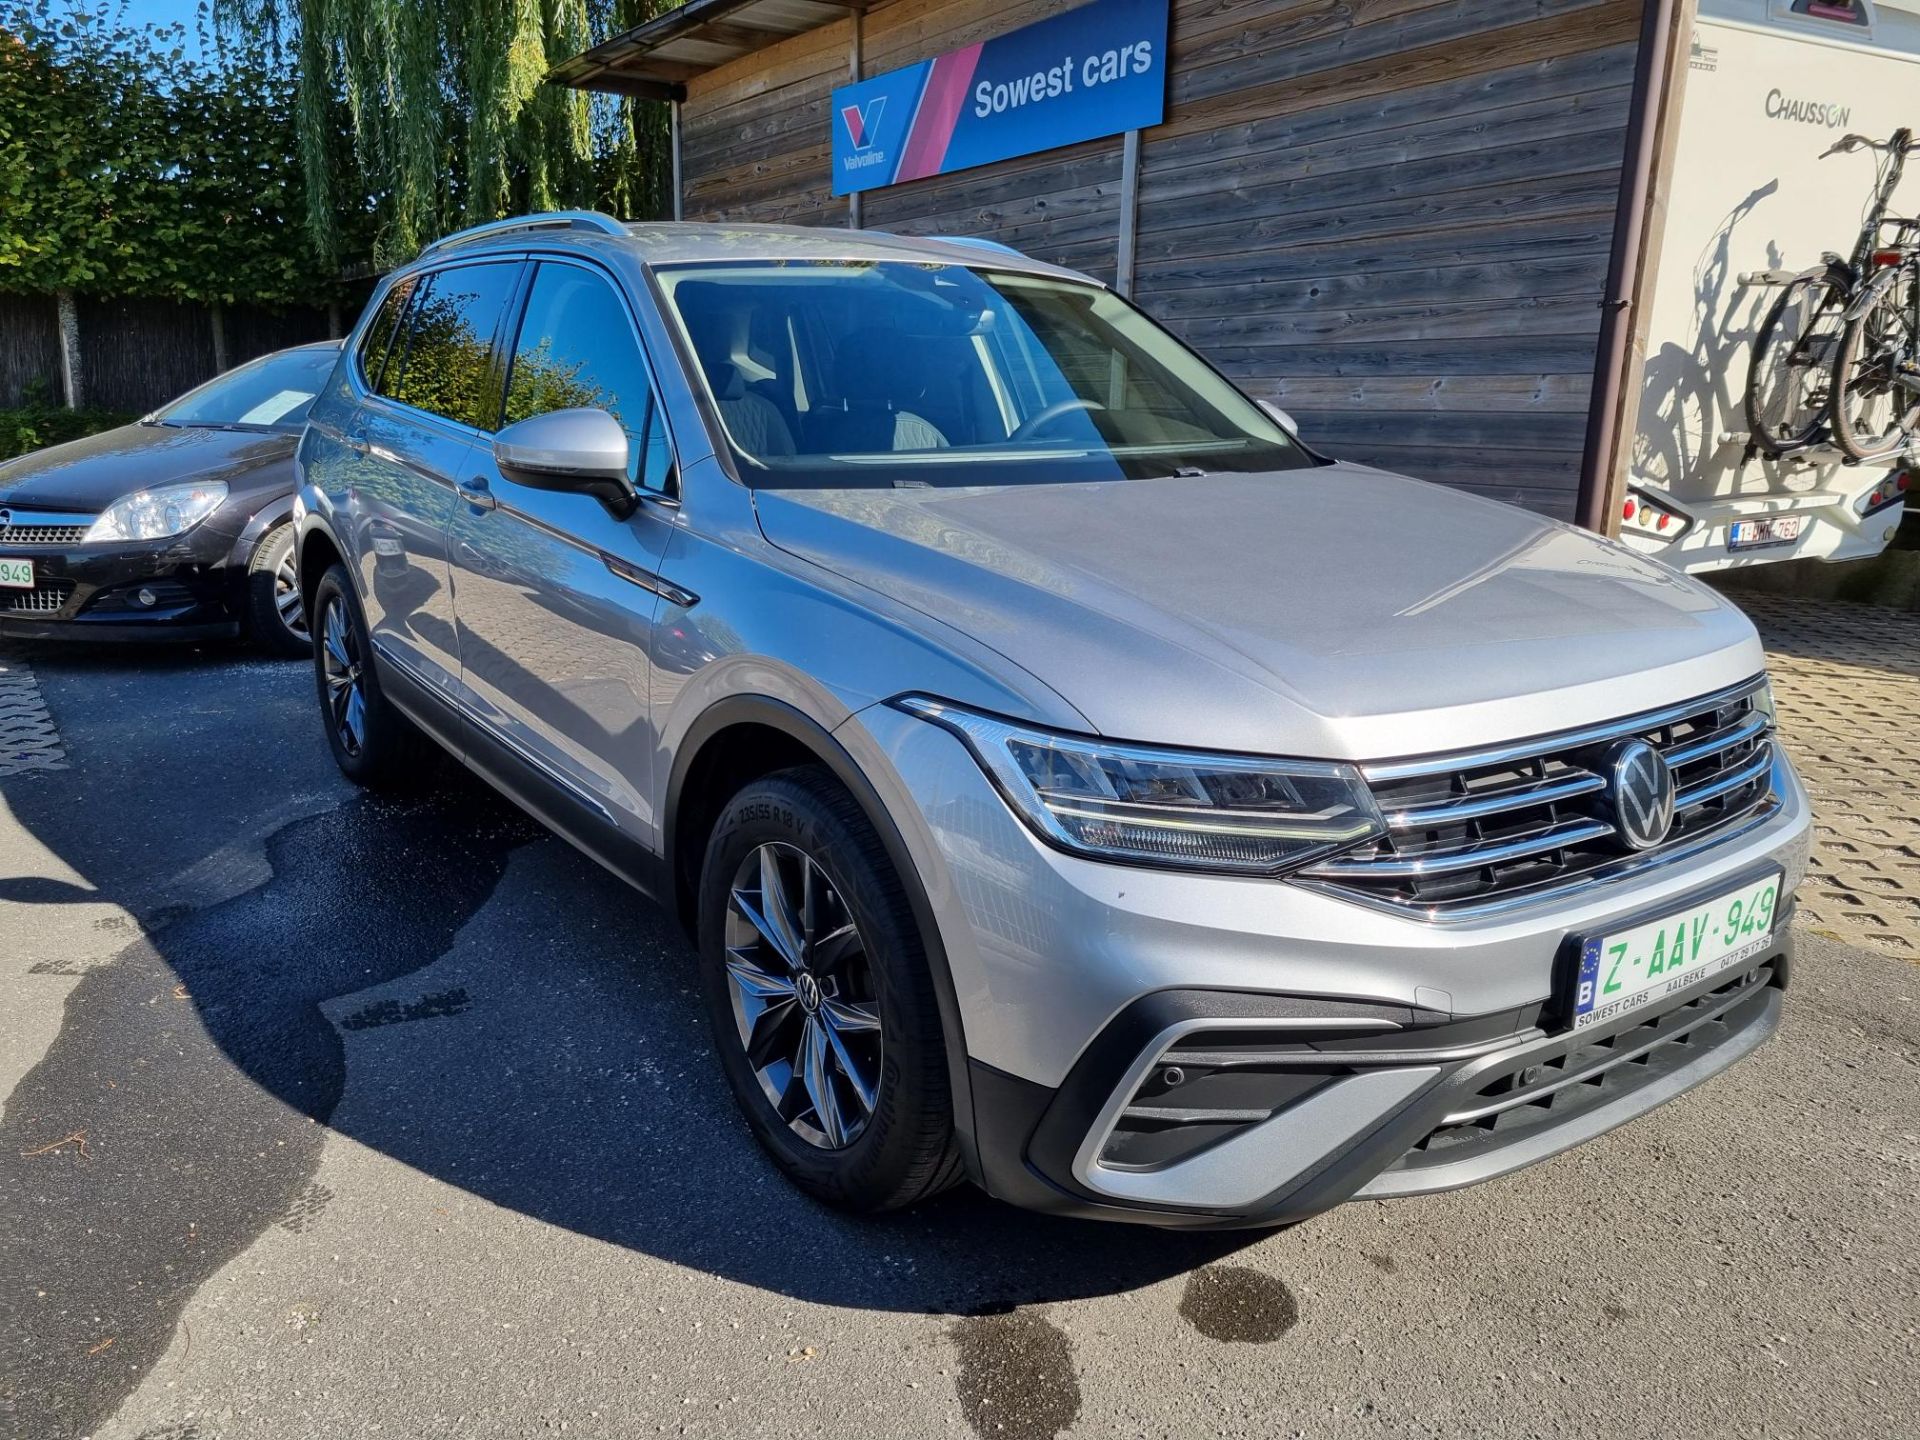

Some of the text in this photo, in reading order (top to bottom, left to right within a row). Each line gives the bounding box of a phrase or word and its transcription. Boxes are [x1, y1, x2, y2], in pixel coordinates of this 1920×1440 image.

[975, 40, 1152, 118] Sowest cars
[844, 151, 884, 171] Valvoline
[739, 803, 770, 824] 235/55
[1603, 886, 1775, 995] Z-AAV-949
[1578, 981, 1593, 1006] B
[1578, 1002, 1620, 1027] SOWEST
[1622, 992, 1649, 1010] CARS
[1666, 968, 1706, 993] AALBEKE
